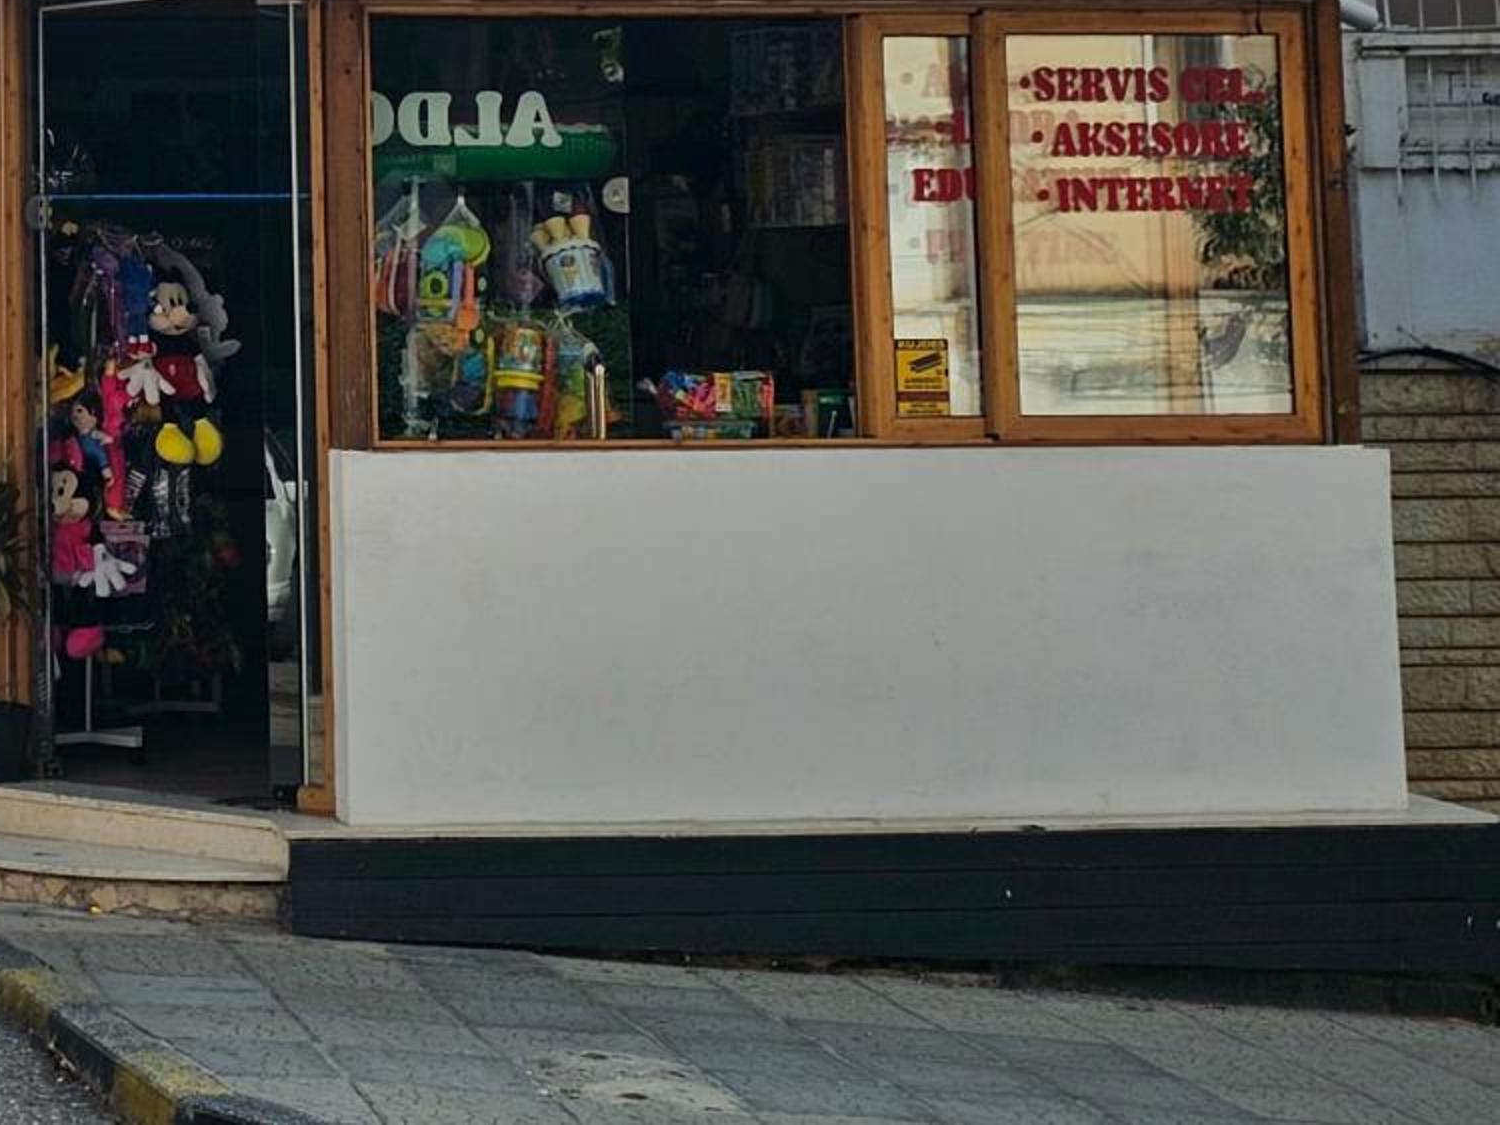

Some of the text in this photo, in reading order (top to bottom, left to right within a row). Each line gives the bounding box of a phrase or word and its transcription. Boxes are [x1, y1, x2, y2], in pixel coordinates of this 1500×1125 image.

[1032, 66, 1170, 103] SERVIS
[1051, 122, 1252, 158] AKSESORE
[1056, 174, 1252, 213] INTERNET
